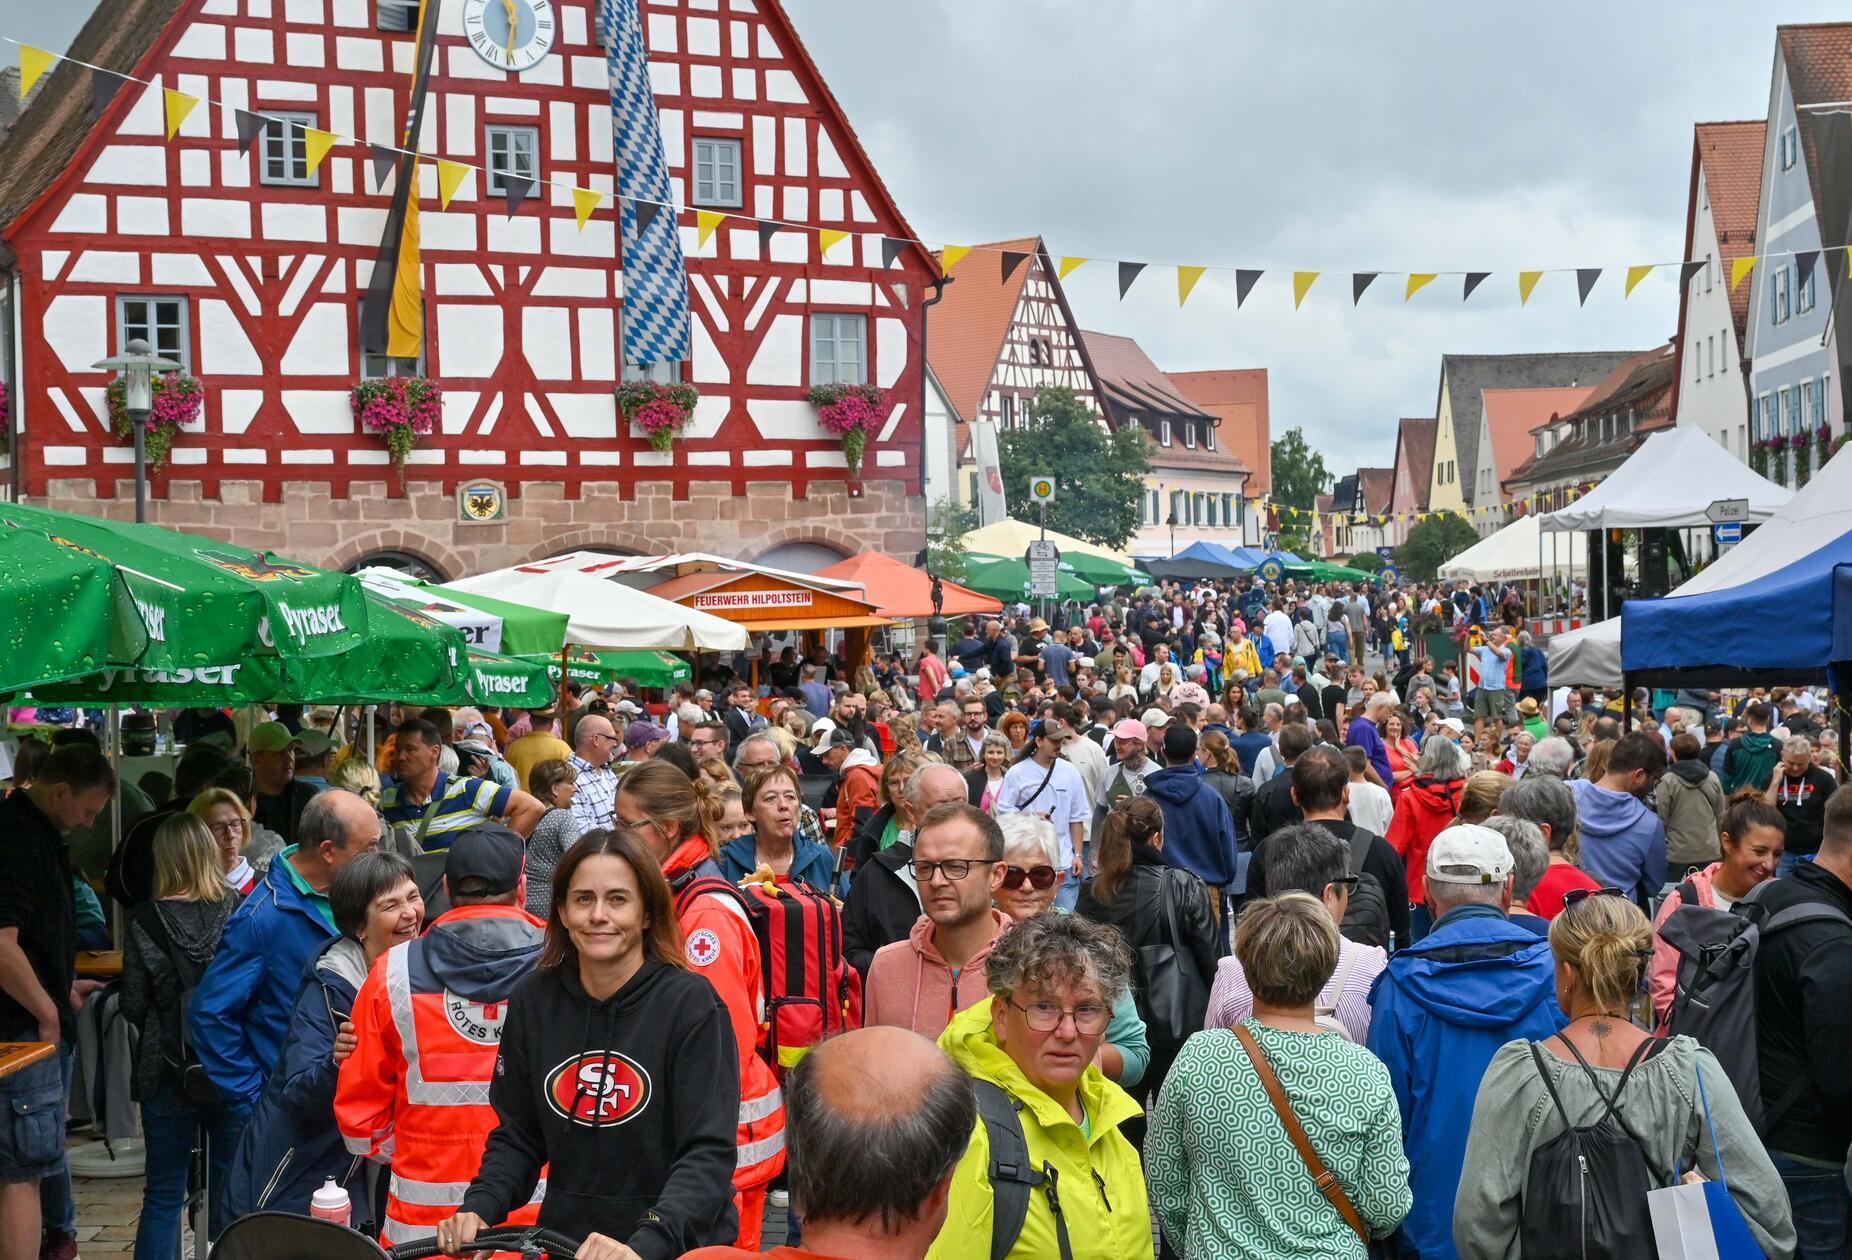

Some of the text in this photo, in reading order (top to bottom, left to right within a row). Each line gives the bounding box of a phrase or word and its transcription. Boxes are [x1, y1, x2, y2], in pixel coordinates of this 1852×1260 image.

[1493, 567, 1541, 578] Schattenhofe
[695, 592, 811, 606] FEUERWEHR HILPOLTSTEIN
[278, 602, 346, 646] Pyraser
[476, 668, 528, 697] Pyraser
[451, 1001, 487, 1038] ROTES
